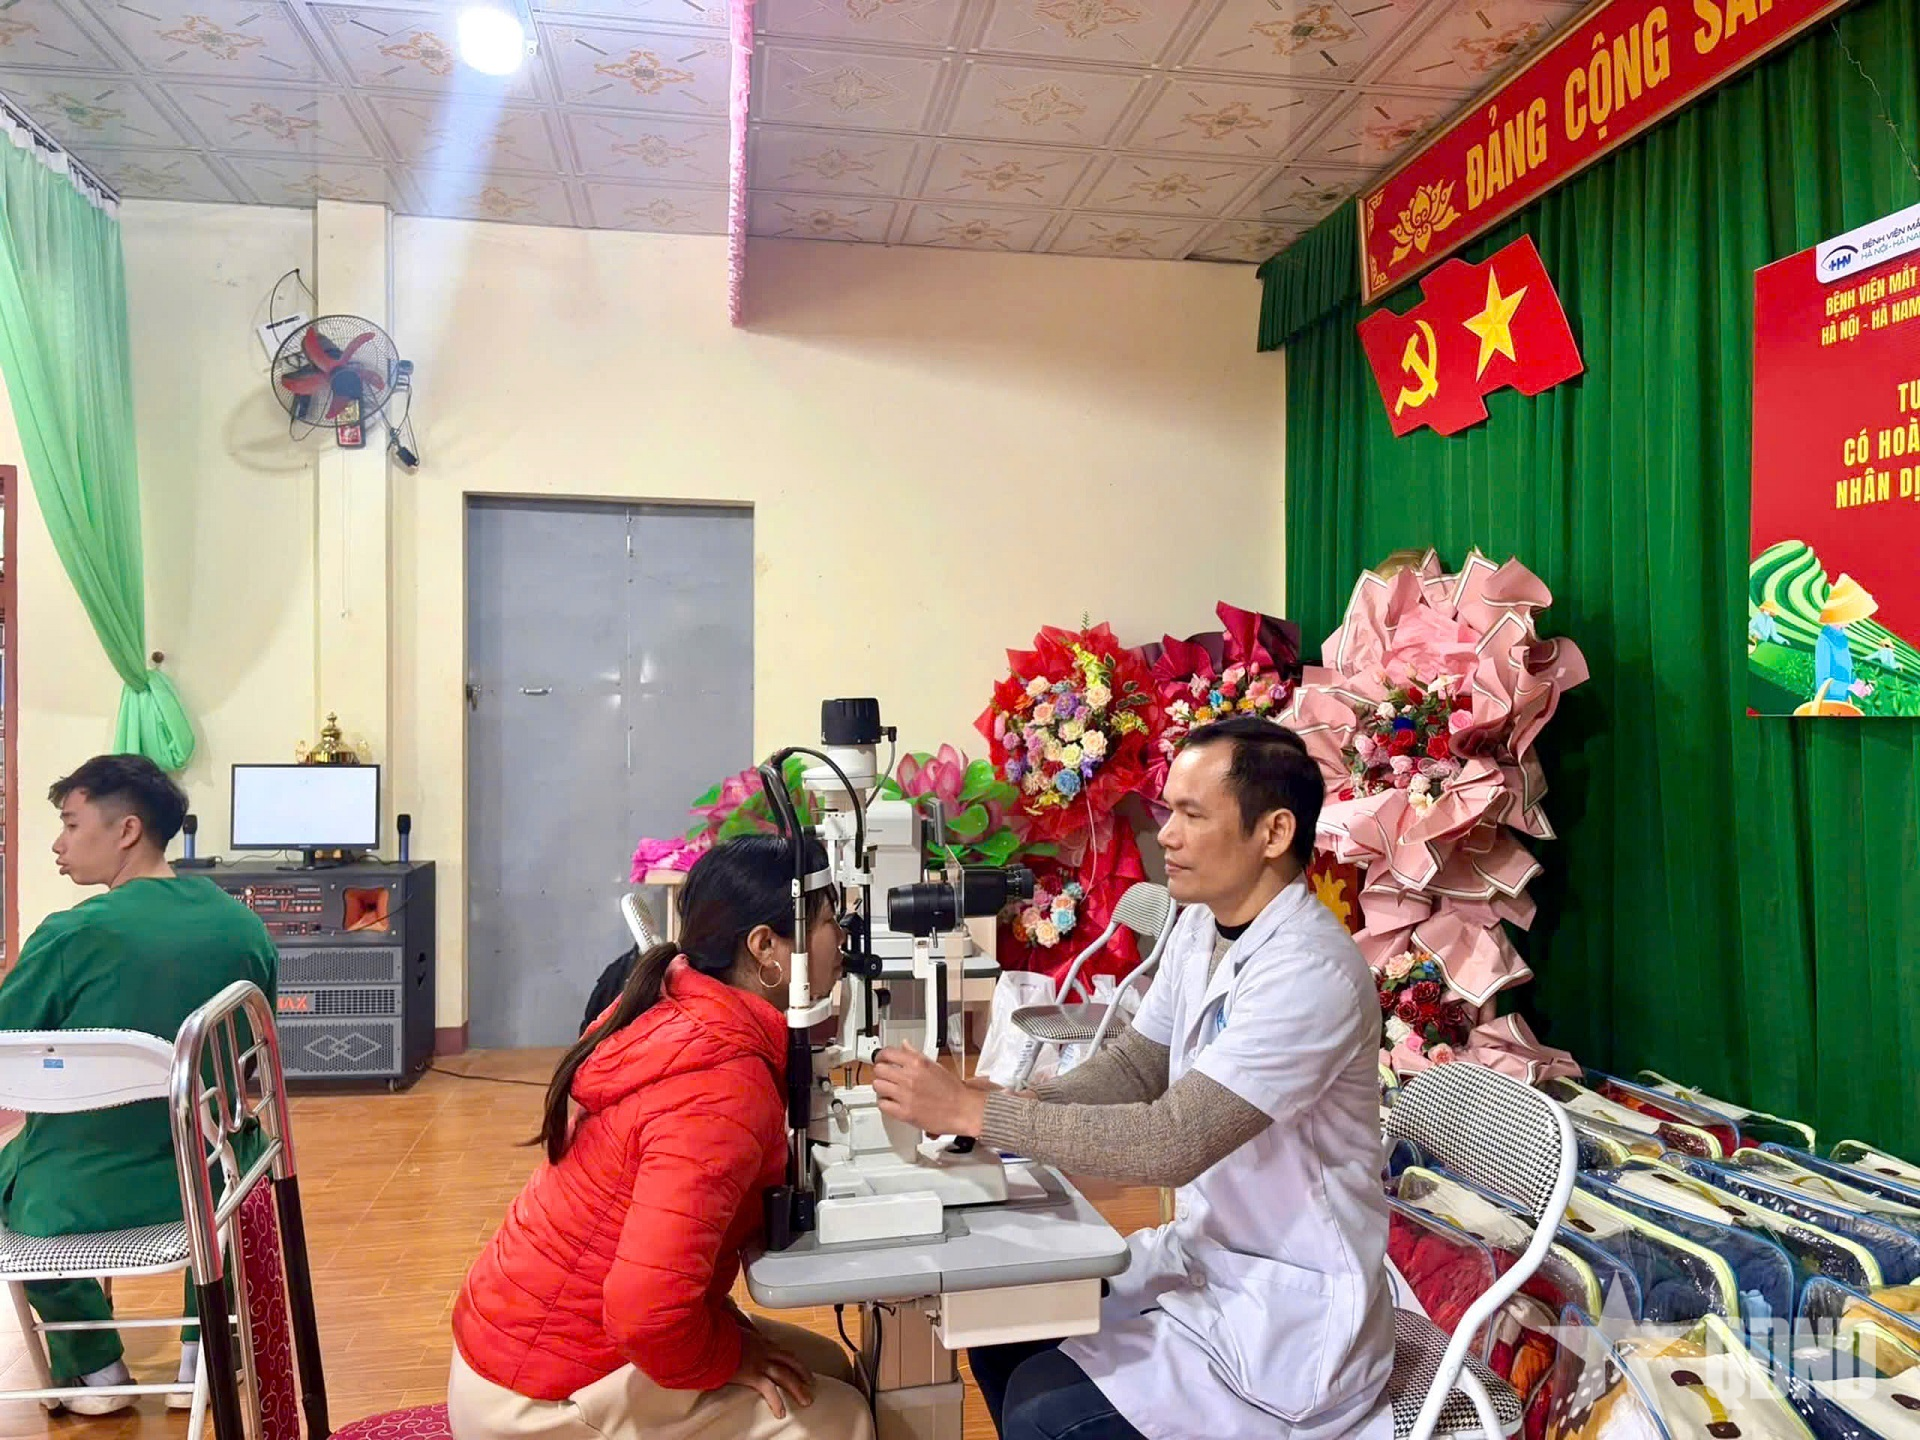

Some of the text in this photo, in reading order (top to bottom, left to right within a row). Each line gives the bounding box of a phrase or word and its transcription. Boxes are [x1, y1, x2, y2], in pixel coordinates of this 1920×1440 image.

[1466, 97, 1547, 210] ĐẢNG
[1564, 6, 1670, 141] CỘNG
[1826, 262, 1918, 317] BỆNH VIỆN MẮT
[1822, 320, 1837, 346] HÀ
[1840, 314, 1860, 342] NỘI
[1871, 303, 1888, 330] HÀ
[1892, 295, 1920, 323] NAM
[1844, 428, 1869, 467] CÓ
[1836, 467, 1889, 509] NHÂN
